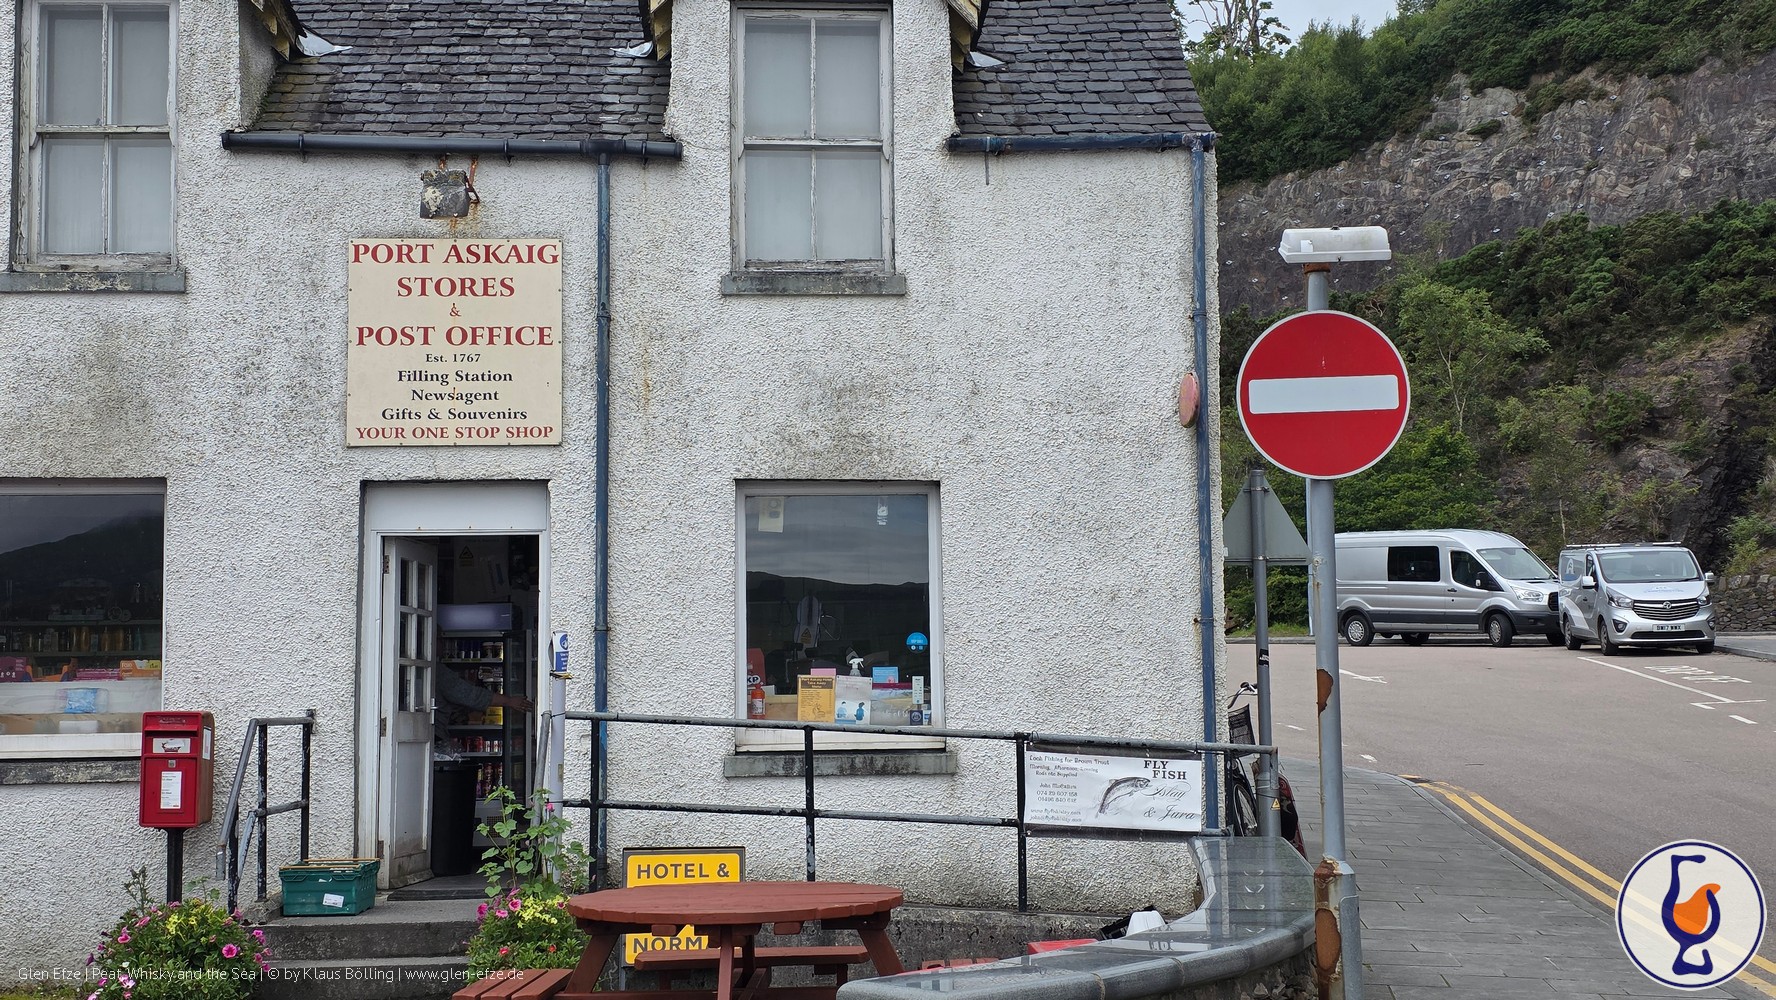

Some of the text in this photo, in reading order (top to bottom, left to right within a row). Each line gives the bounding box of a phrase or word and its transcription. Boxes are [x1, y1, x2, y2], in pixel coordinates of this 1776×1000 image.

[351, 243, 559, 264] PORT ASKAIG
[397, 277, 515, 297] STORES
[449, 306, 461, 317] &
[356, 326, 554, 346] POST OFFICE
[425, 353, 481, 363] Est. 1767
[397, 370, 513, 386] Filling Station
[411, 389, 499, 405] Newsagent
[381, 408, 527, 420] Gifts & Souvenirs
[356, 426, 553, 440] YOUR ONE STOP SHOP
[1143, 760, 1169, 769] FLY
[1152, 770, 1187, 780] FISH
[1141, 781, 1191, 802] Islay
[1143, 805, 1195, 821] & Jura
[637, 863, 730, 879] HOTEL &
